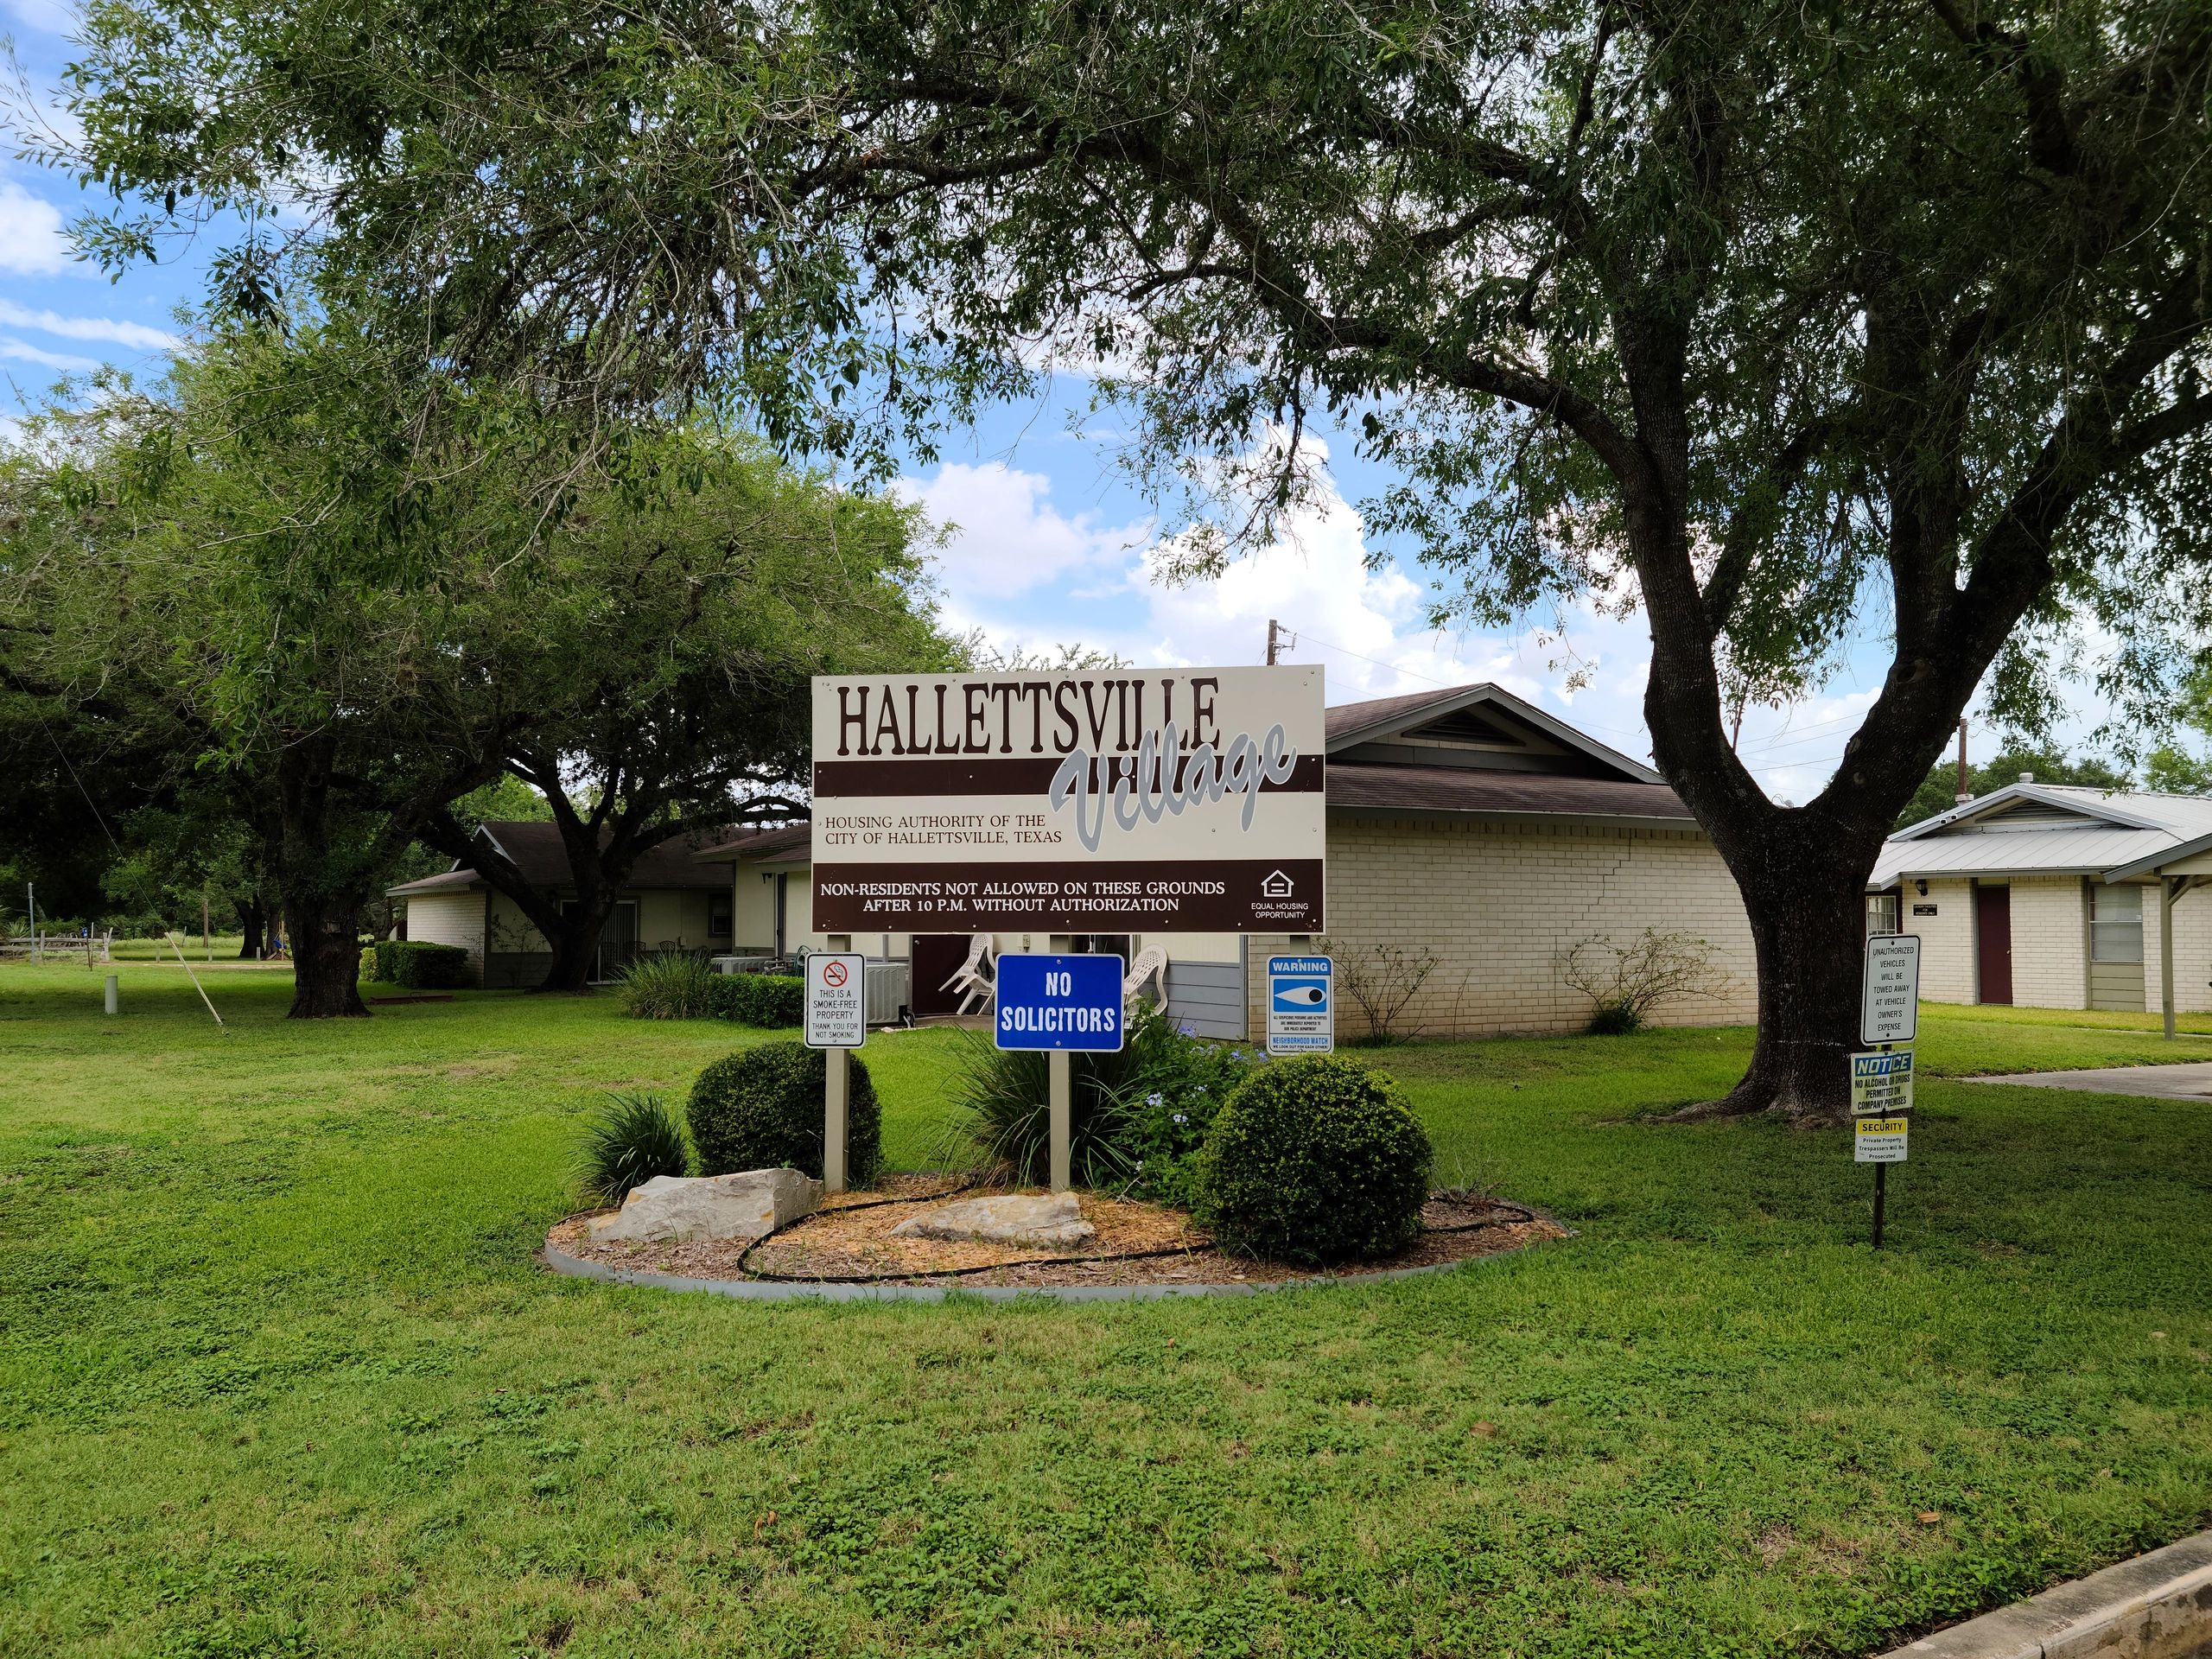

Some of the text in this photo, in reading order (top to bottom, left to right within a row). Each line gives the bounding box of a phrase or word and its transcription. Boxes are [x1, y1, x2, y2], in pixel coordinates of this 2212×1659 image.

[837, 677, 1219, 755] HALLETTSVILLE
[1049, 721, 1298, 854] Village
[825, 815, 1046, 829] HOUSING AUTHORITY OF THE
[825, 830, 1062, 845] CITY OF HALLETTSVILLE, TEXAS
[821, 881, 1225, 896] NON-RESIDENTS NOT ALLOWED ON THESE GROUNDS
[863, 898, 1179, 912] AFTER 10 P.M. WITHOUT AUTHORIZATION
[1872, 946, 1915, 956] UNAUTHORIZED
[1273, 962, 1328, 971] WARNING
[1880, 959, 1905, 968] VEHICLES
[1046, 972, 1071, 996] NO
[820, 989, 851, 998] THIS IS A
[1885, 997, 1906, 1006] VEHICLE
[1001, 1006, 1116, 1033] SOLICITORS
[1878, 1009, 1903, 1019] OWNER'S
[1878, 1022, 1901, 1031] EXPENSE
[1857, 1054, 1910, 1075] NOTICE
[1855, 1074, 1910, 1089] NO ALCOHOL OR DRUGS
[1866, 1086, 1901, 1098] PERMITTED ON
[1858, 1096, 1907, 1109] COMPANY PREMISES
